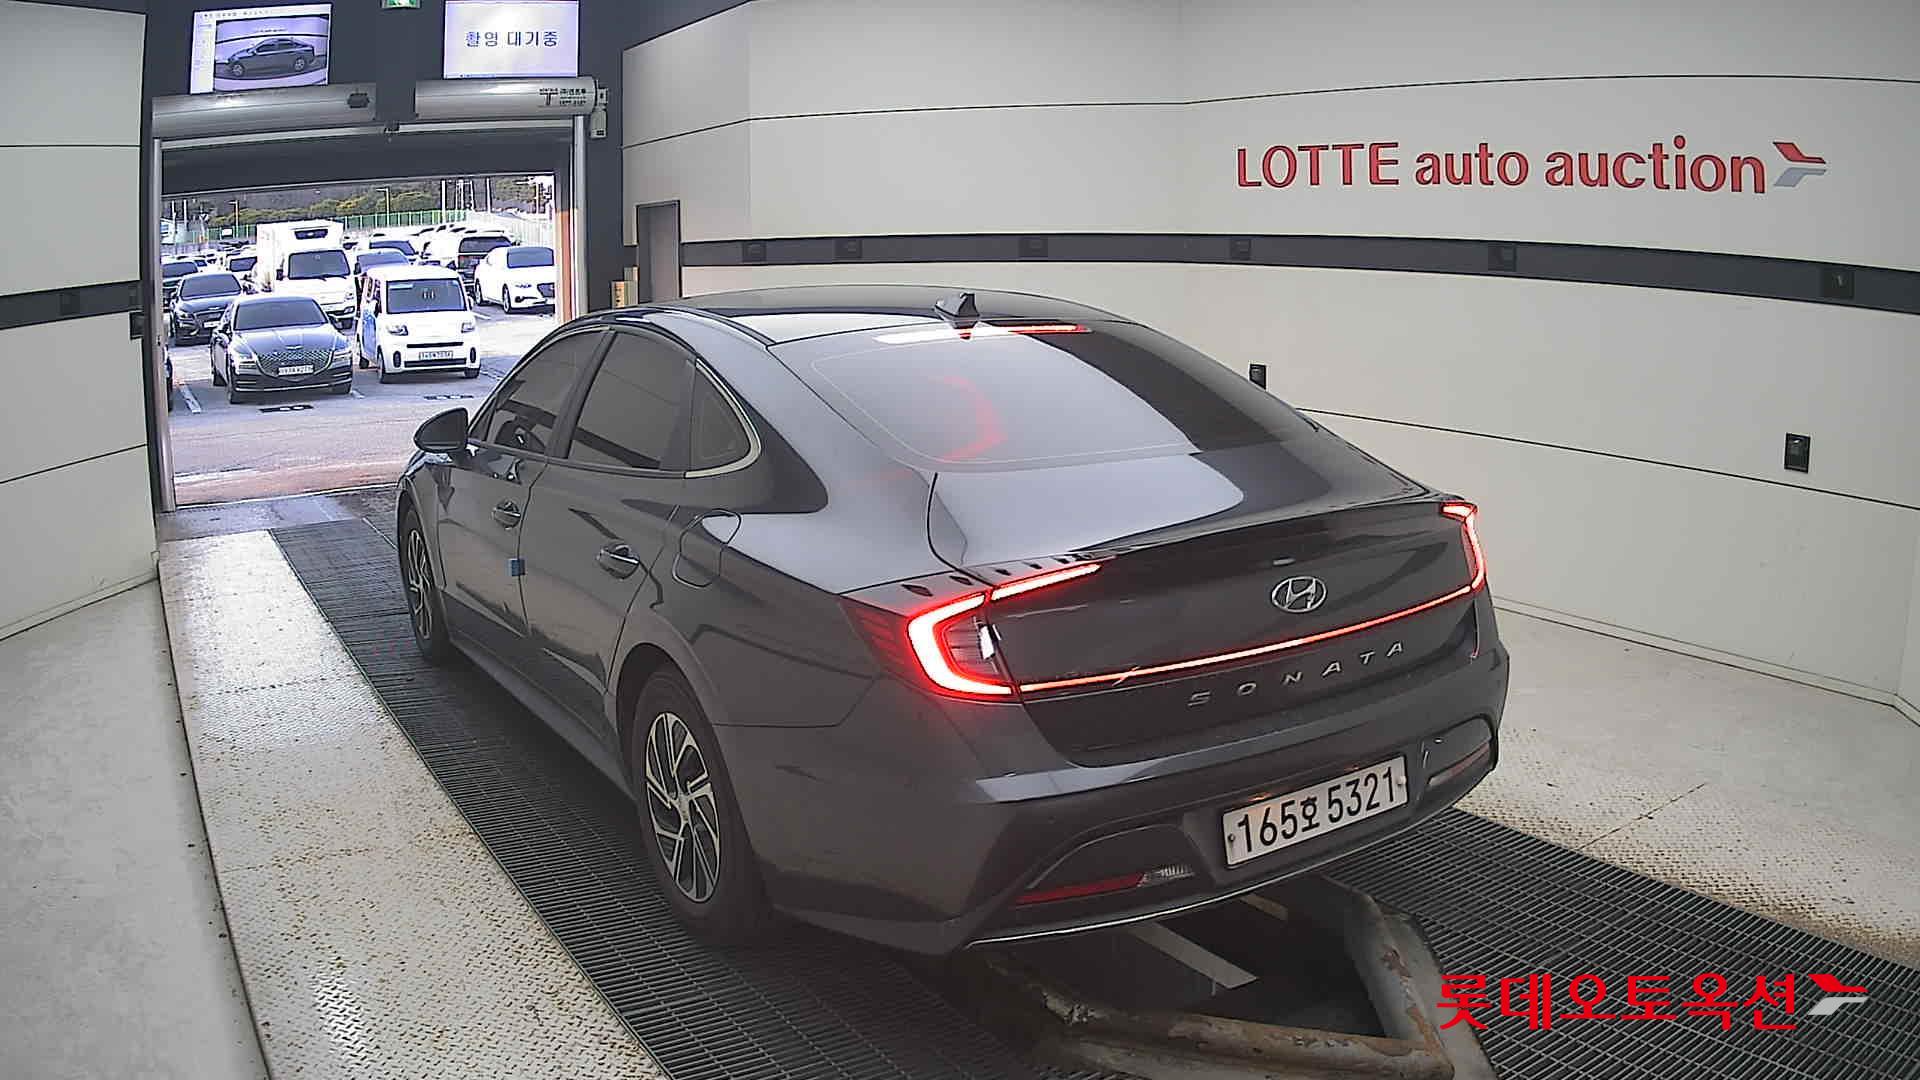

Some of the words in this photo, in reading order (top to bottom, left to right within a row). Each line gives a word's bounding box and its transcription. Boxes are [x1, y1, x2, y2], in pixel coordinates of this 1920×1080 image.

[507, 31, 558, 47] 대기중
[1237, 142, 1399, 187] LOTTE
[1416, 143, 1530, 186] auto
[1545, 135, 1767, 194] auction
[1187, 640, 1404, 706] SONATA
[1328, 766, 1395, 824] 5321
